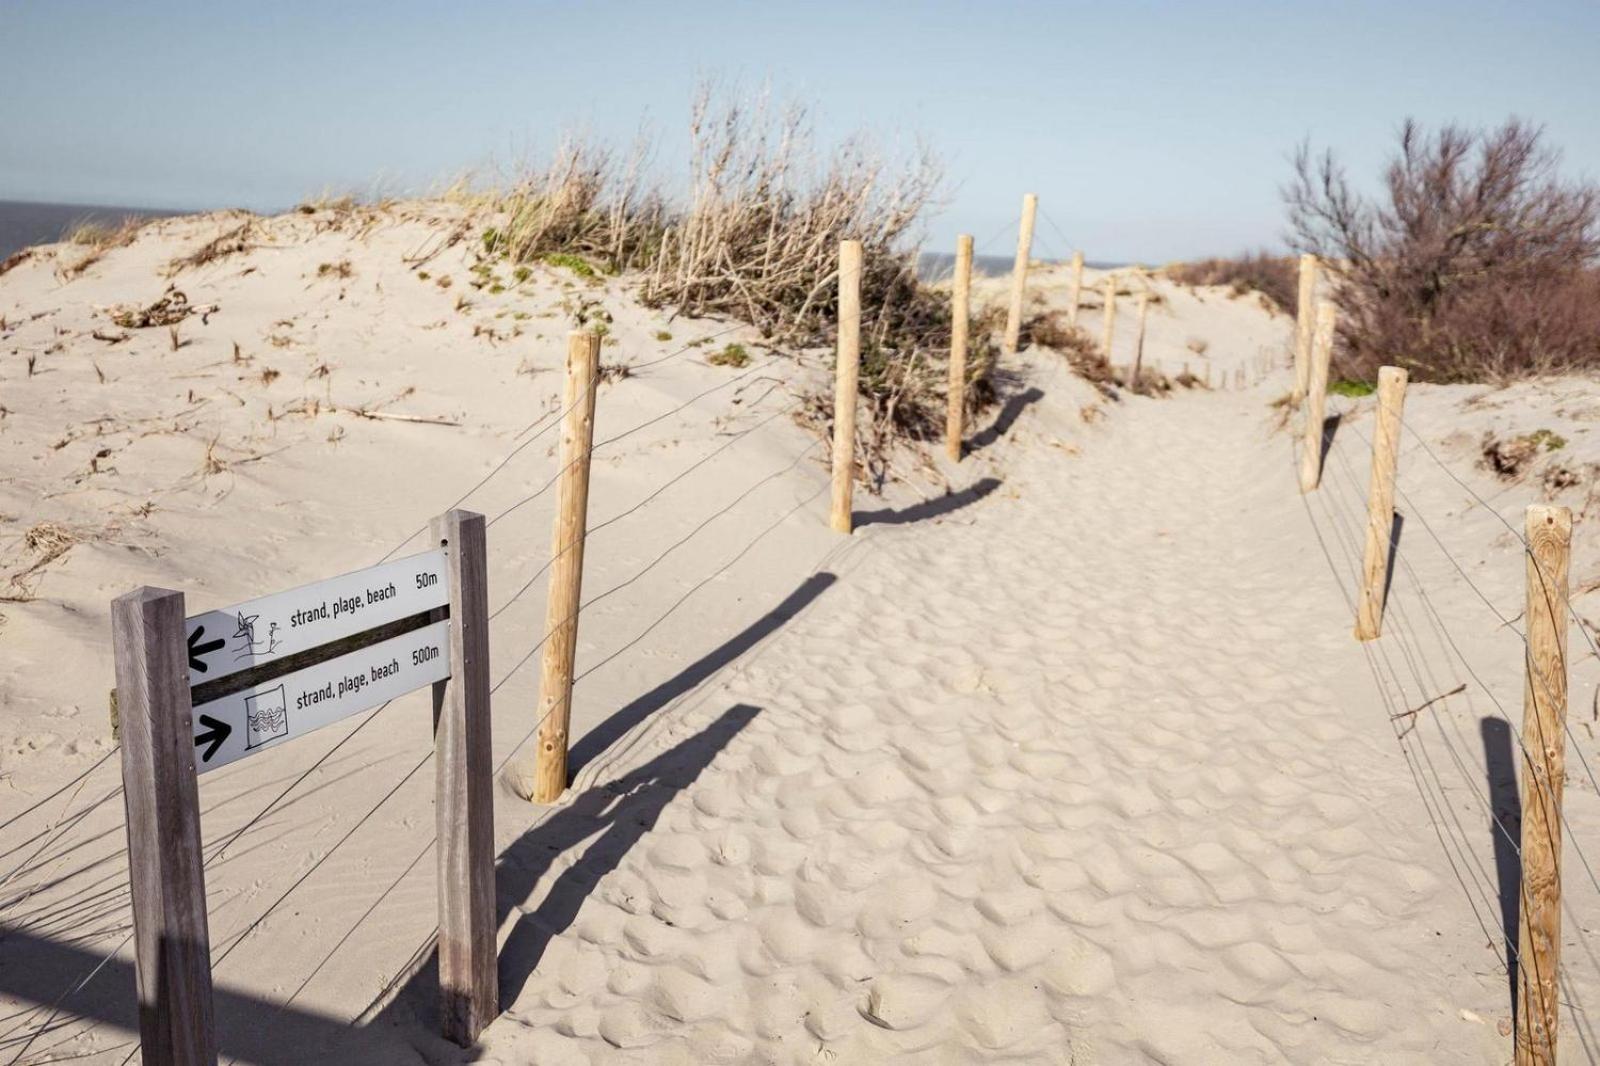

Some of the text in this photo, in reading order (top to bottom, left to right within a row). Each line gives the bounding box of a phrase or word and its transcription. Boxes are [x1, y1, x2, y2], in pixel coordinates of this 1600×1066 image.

[366, 583, 396, 605] beach
[416, 572, 438, 589] 50m
[371, 659, 399, 682] beach
[412, 646, 440, 666] 500m
